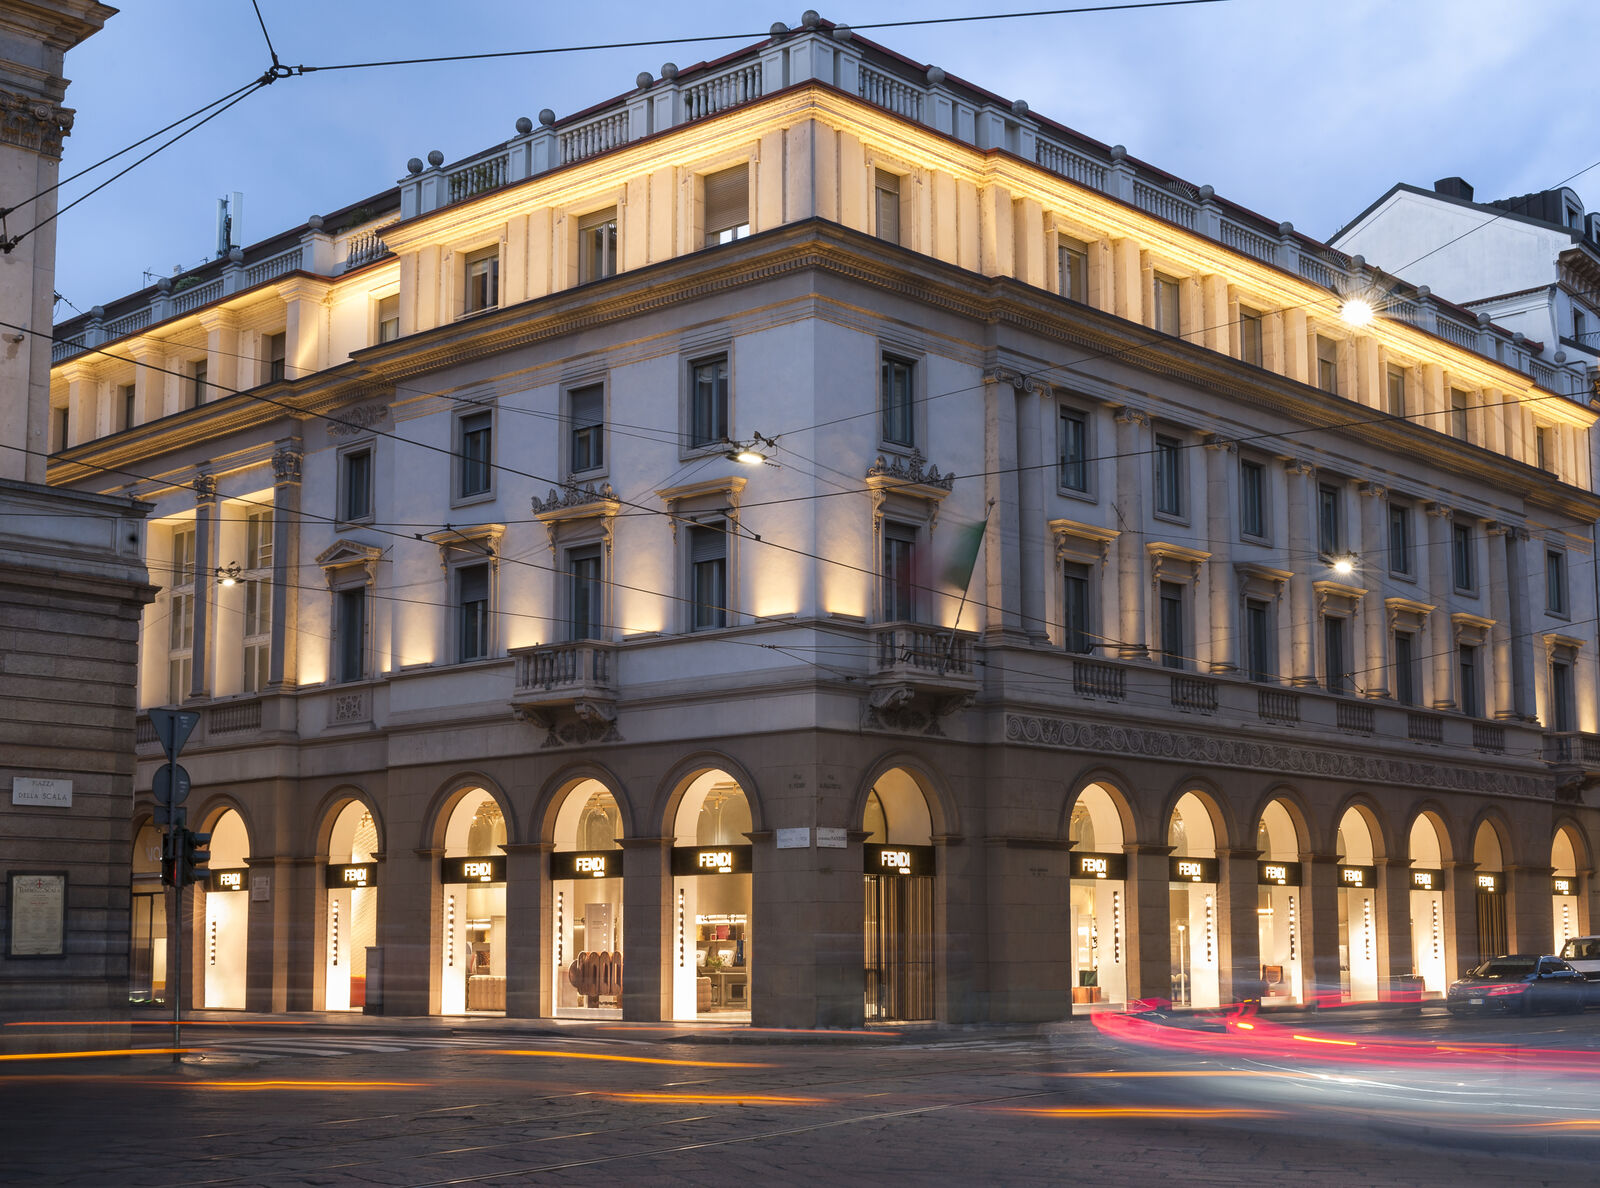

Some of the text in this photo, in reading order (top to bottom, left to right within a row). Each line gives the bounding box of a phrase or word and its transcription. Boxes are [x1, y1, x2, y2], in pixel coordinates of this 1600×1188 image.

[18, 791, 67, 801] DELLA SCALA
[576, 857, 604, 872] FENDI
[700, 852, 731, 867] FENDI
[882, 852, 910, 867] FENDI
[1083, 859, 1106, 873] FENDI
[345, 868, 367, 882] FENDI
[464, 863, 491, 877] FENDI
[1179, 863, 1200, 876] FENDI
[1266, 867, 1286, 880] FENDI
[1344, 870, 1362, 882] FENDI
[221, 873, 241, 886] FENDI
[1415, 874, 1431, 885] FENDI
